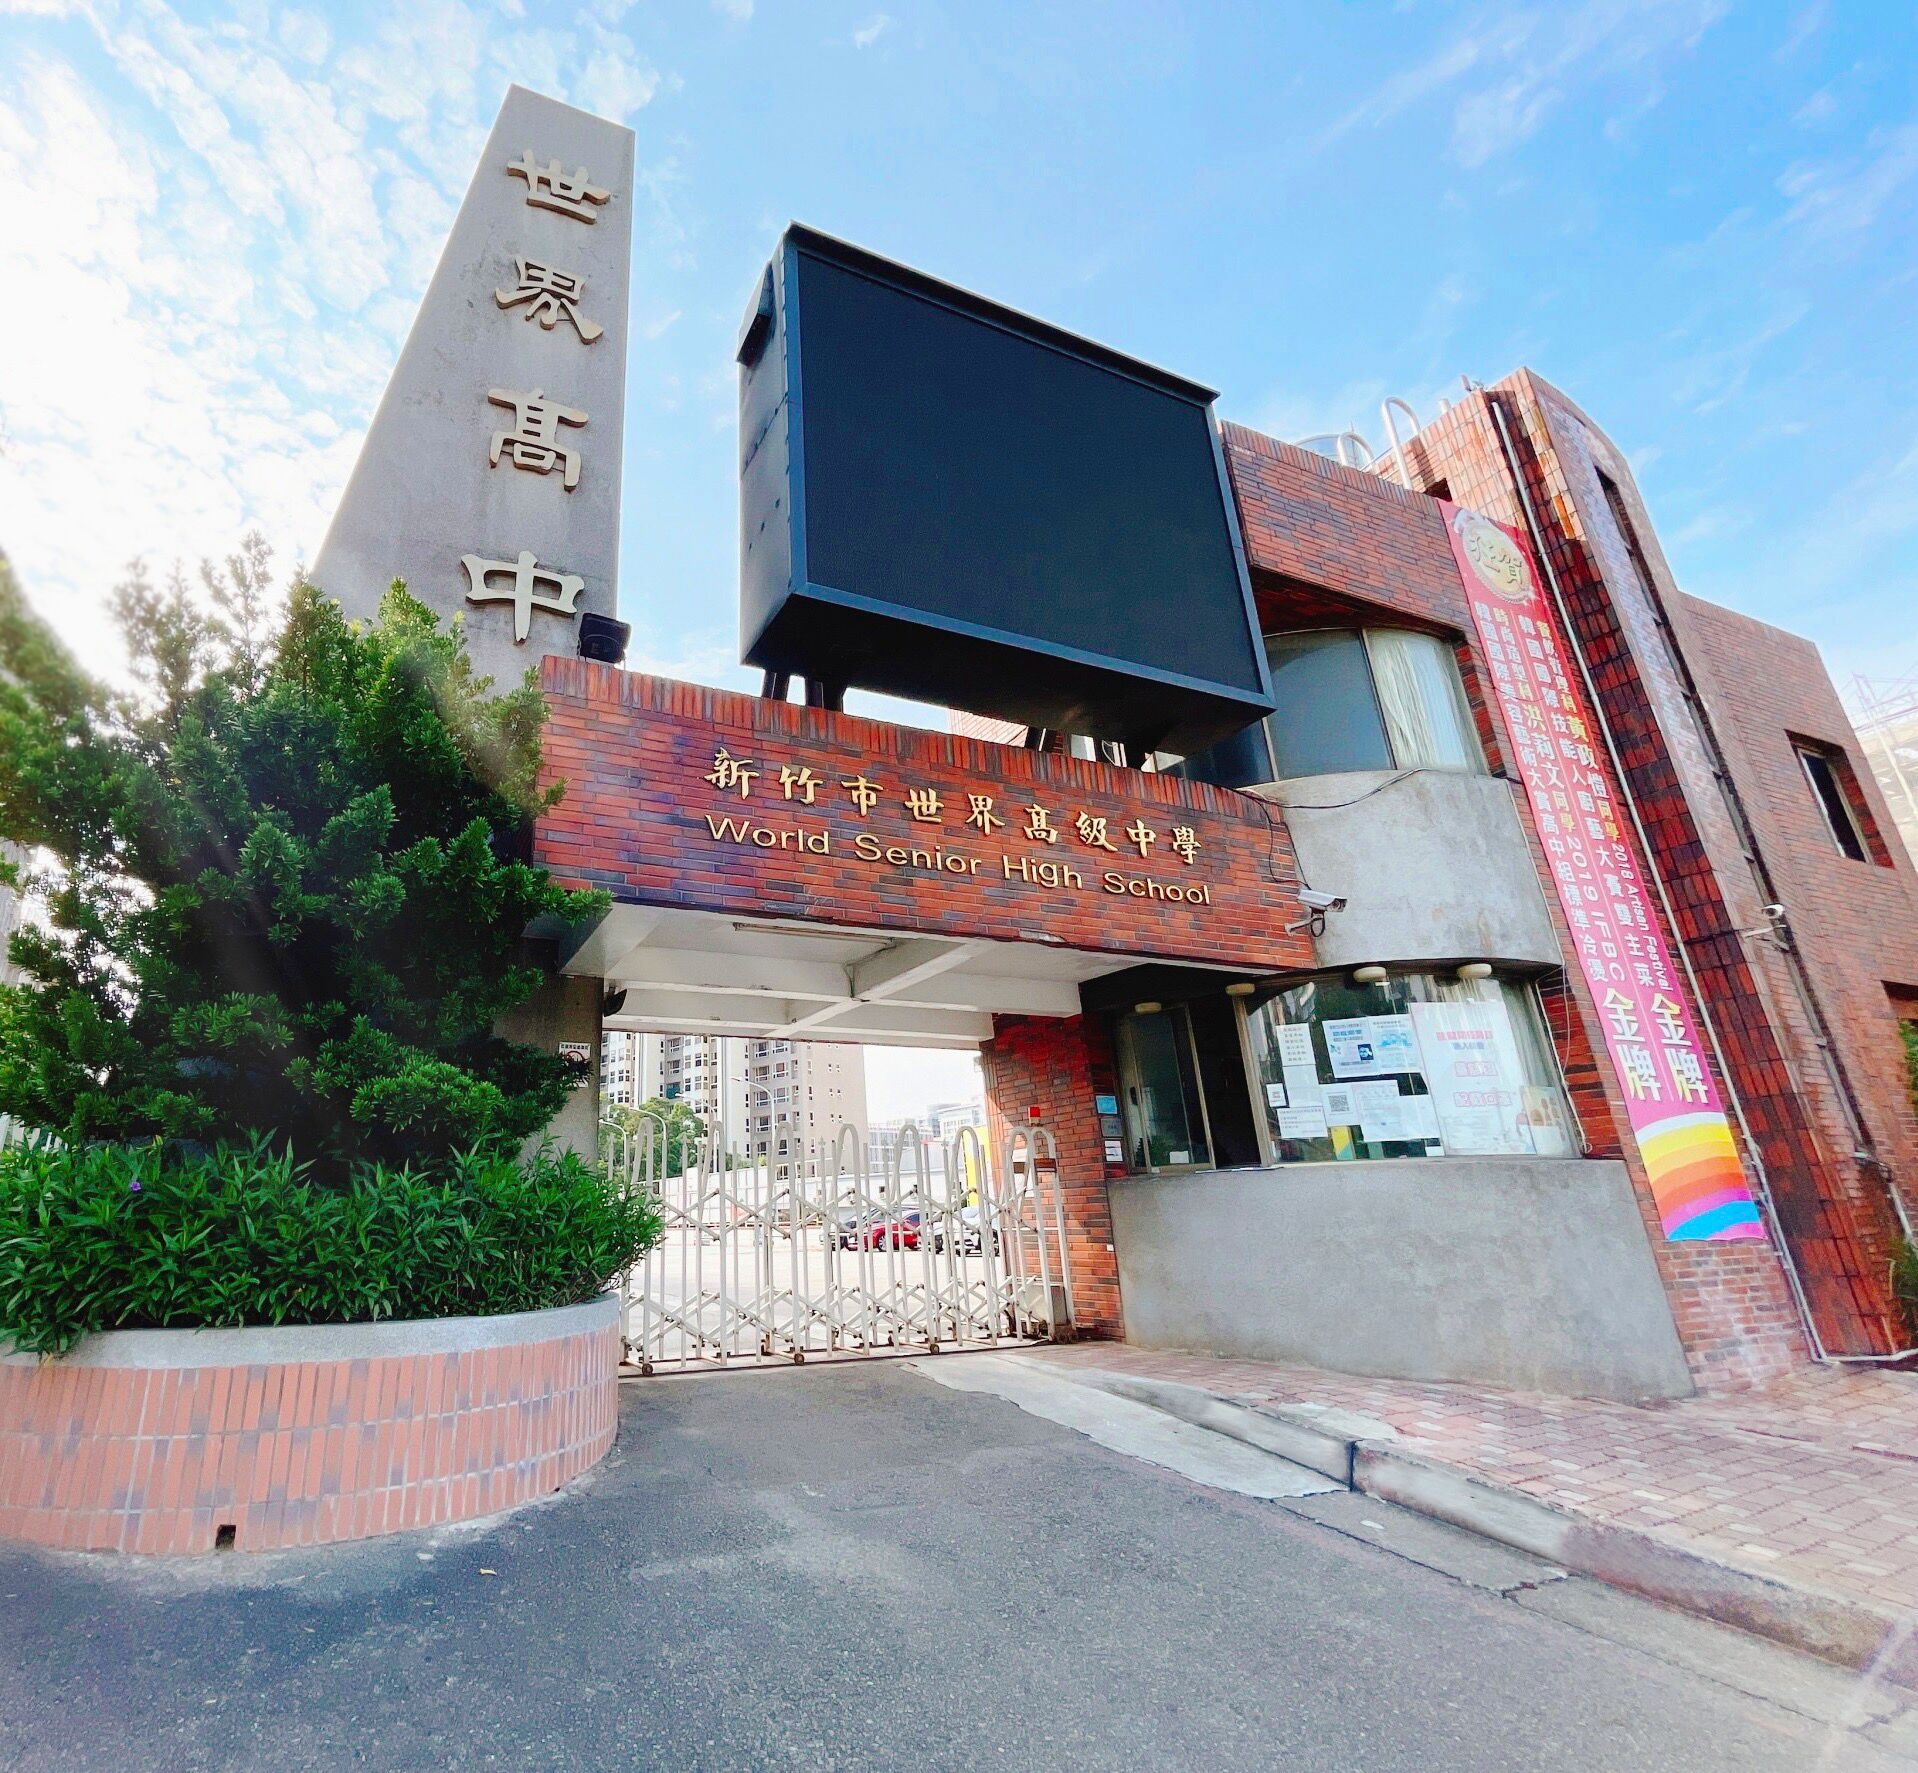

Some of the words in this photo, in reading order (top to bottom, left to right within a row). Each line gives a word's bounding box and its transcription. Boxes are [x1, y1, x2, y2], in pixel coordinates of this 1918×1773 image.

[703, 747, 1203, 867] 新竹市世界高級中學
[704, 813, 831, 857] World
[853, 832, 983, 877] Senior
[1002, 854, 1083, 892] High
[1102, 871, 1211, 907] School
[1565, 834, 1600, 902] 2019
[1591, 910, 1625, 982] IFBC
[1612, 842, 1634, 880] 2018
[1643, 935, 1674, 992] Festival
[1602, 987, 1662, 1103] 金牌
[1650, 992, 1709, 1104] 金牌
